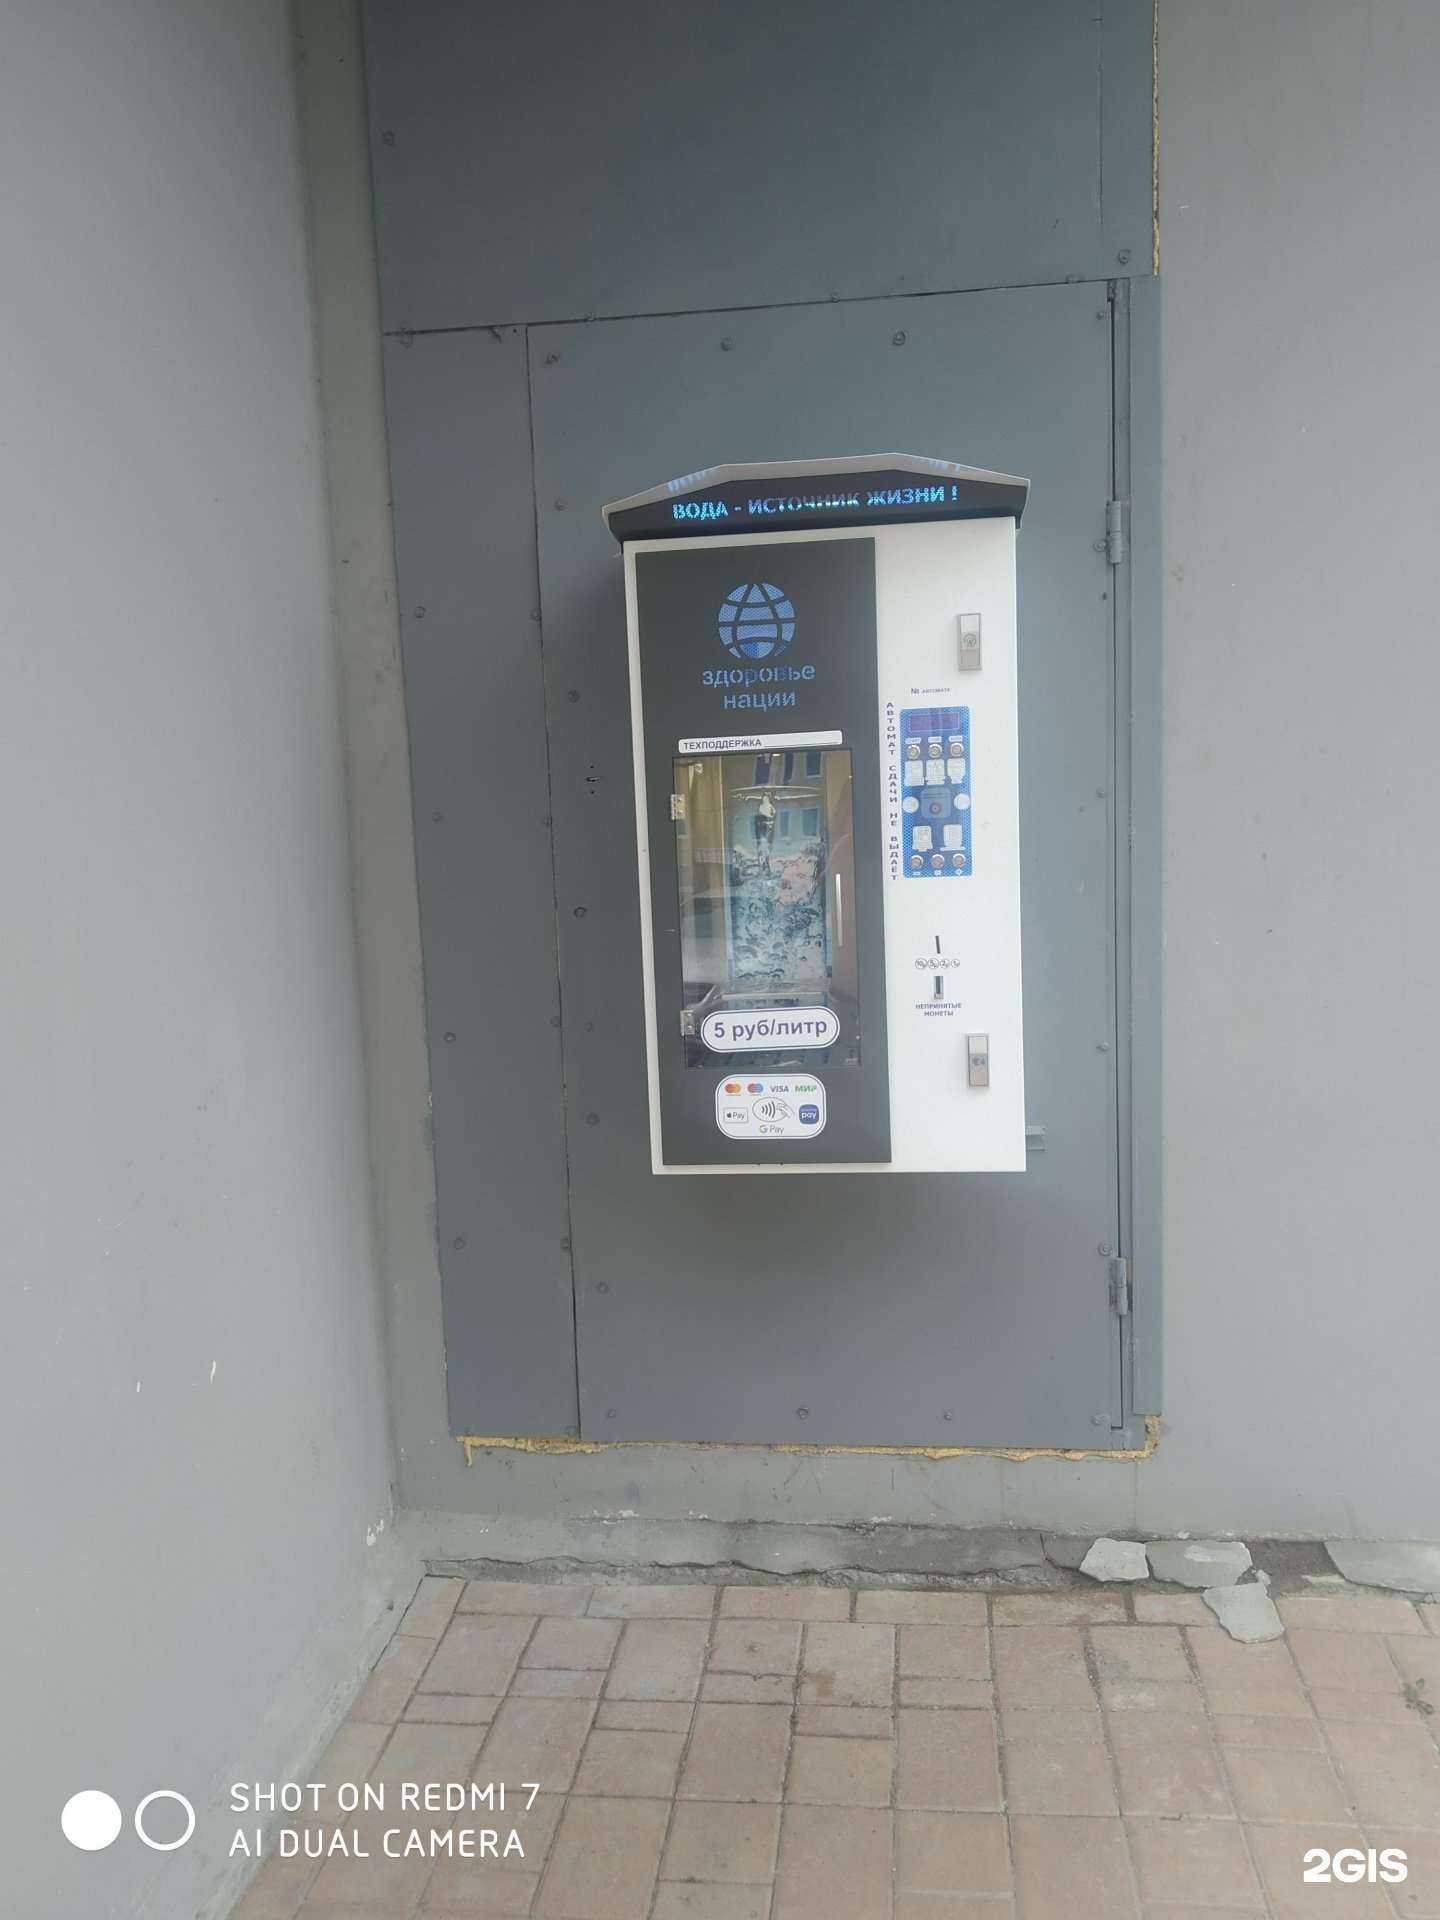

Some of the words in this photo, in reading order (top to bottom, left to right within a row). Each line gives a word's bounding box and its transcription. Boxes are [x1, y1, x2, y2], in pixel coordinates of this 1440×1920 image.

[672, 501, 728, 520] ВОДА
[748, 493, 860, 514] ИСТОЧНИК
[866, 485, 946, 506] ЖИЗНИ
[702, 665, 816, 688] здоровье
[723, 692, 797, 712] нации
[887, 702, 896, 756] АВТОМАТ
[683, 738, 762, 751] ТЕХПОДДЕРЖКА
[889, 766, 897, 803] СДАЧИ
[890, 813, 897, 826] НЕ
[714, 1022, 726, 1038] 5
[732, 1018, 828, 1041] руб/литр
[769, 1085, 790, 1093] VISA
[794, 1085, 817, 1093] МИР
[732, 1111, 746, 1119] Pay
[801, 1112, 818, 1120] pay
[759, 1125, 769, 1133] G
[769, 1125, 784, 1134] Pay
